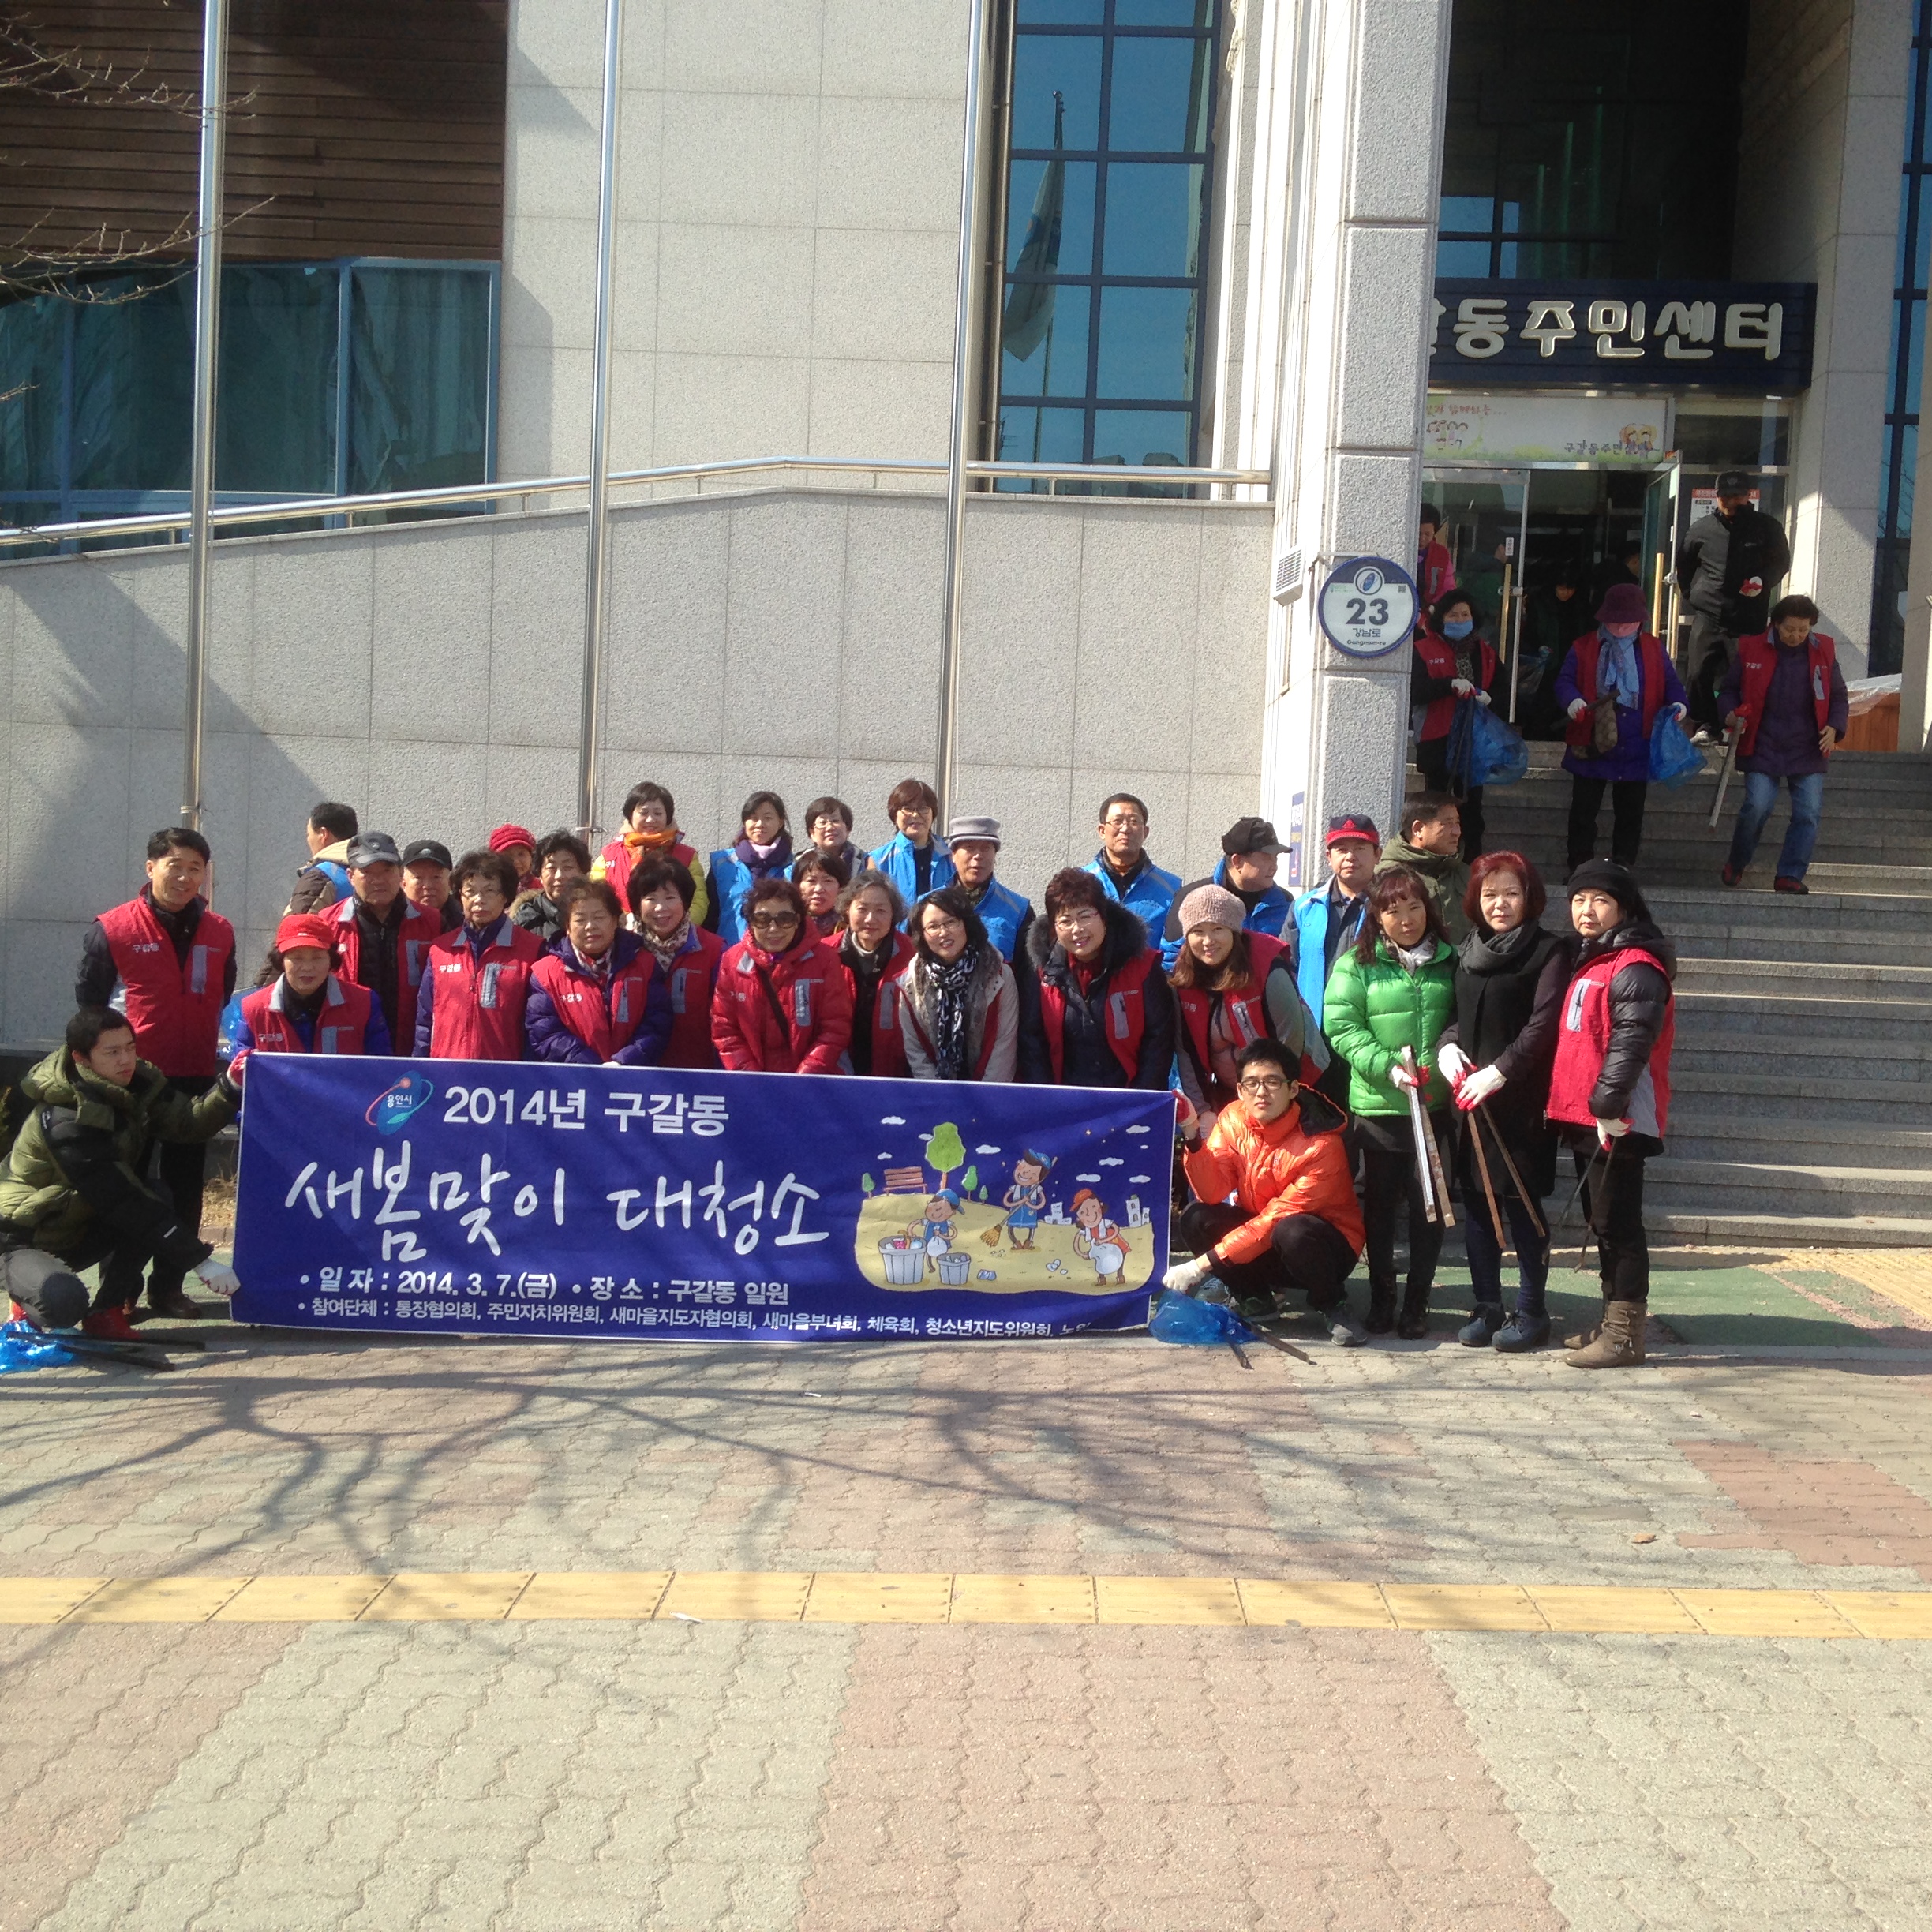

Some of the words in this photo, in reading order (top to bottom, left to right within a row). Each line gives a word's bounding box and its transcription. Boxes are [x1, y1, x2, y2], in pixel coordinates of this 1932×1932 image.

[1345, 597, 1390, 626] 23
[1352, 628, 1381, 638] 강남로
[387, 1095, 412, 1108] 용인시
[444, 1086, 586, 1129] 2014년
[604, 1092, 729, 1136] 구갈동
[285, 1140, 565, 1263] 새봄맞이
[606, 1159, 829, 1256] 대청소
[668, 1279, 737, 1305] 구갈동
[743, 1281, 789, 1305] 일원
[312, 1297, 378, 1317] 참여단체
[395, 1300, 481, 1321] 통장협의회,
[487, 1302, 605, 1325] 주민자치위원회,
[867, 1316, 919, 1335] 체육회,
